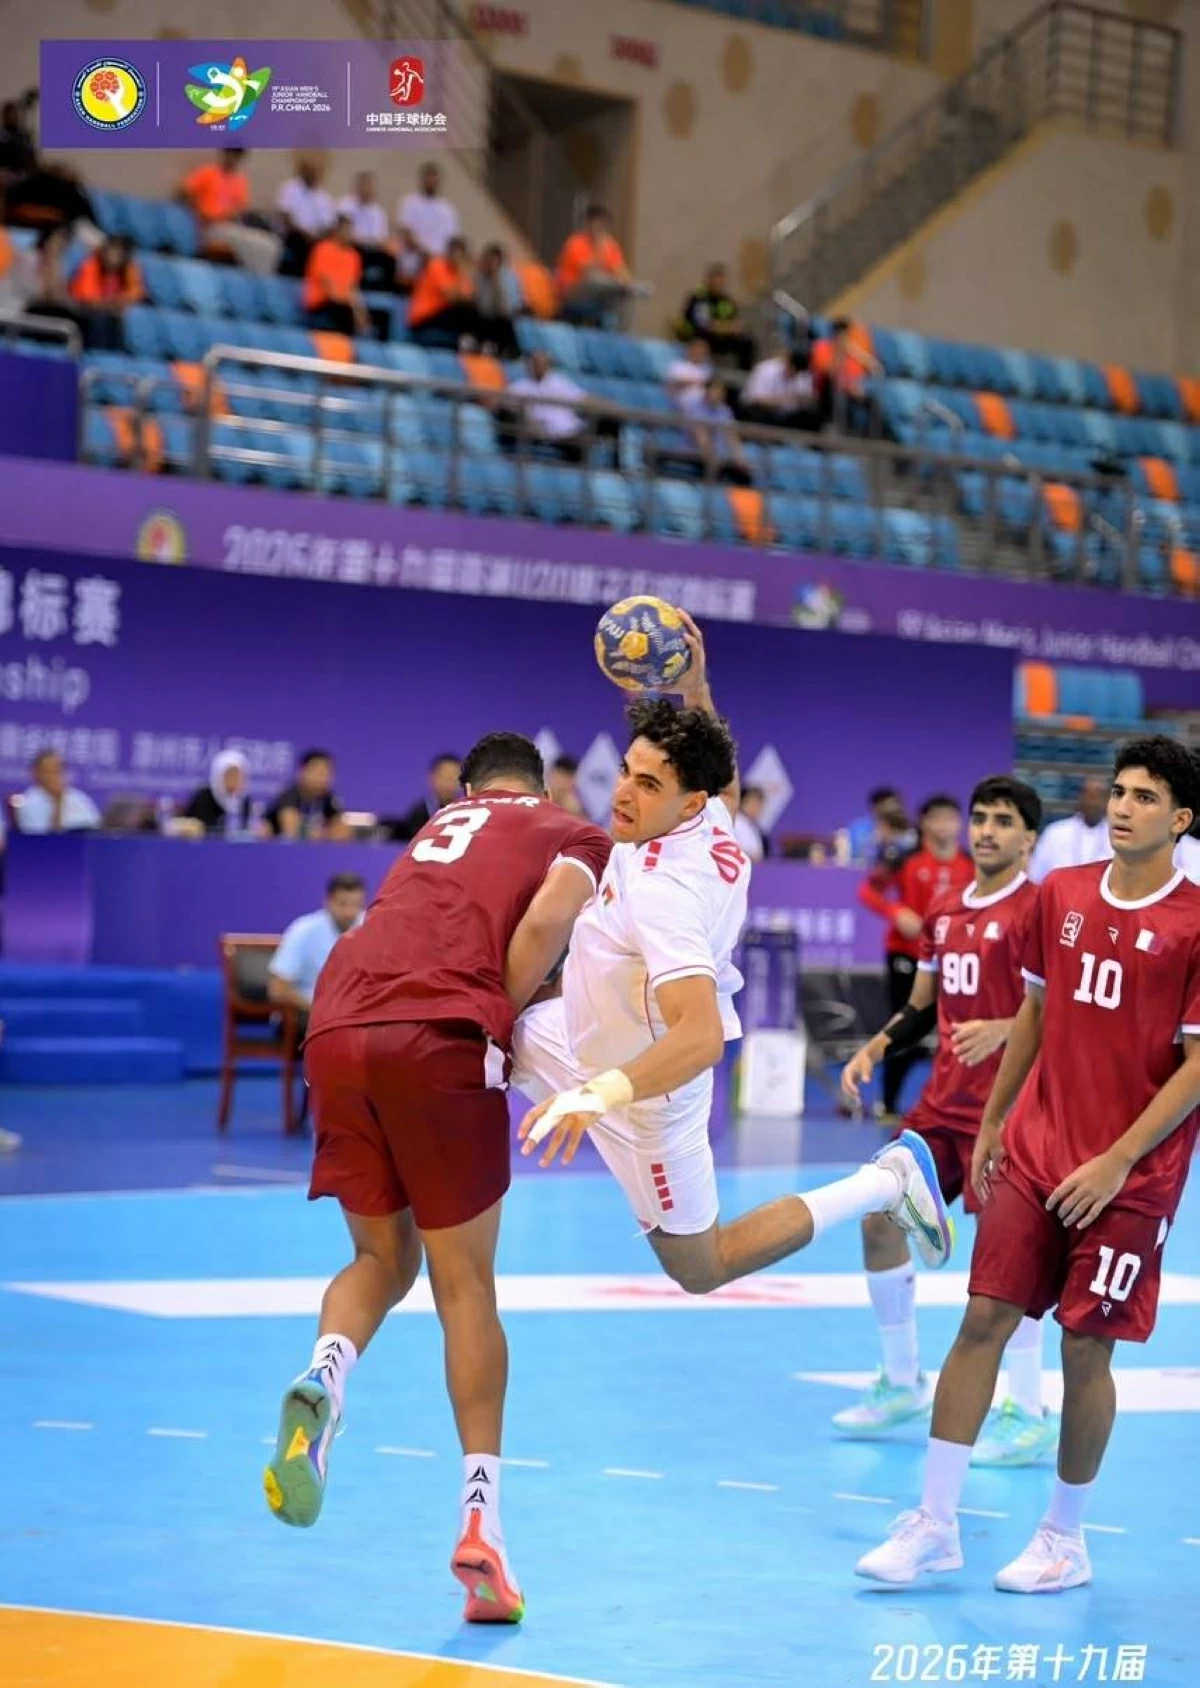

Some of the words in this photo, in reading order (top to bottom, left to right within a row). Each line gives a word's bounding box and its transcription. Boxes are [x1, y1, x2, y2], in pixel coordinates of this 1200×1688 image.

[411, 807, 492, 865] 3
[942, 952, 980, 996] 90
[1073, 951, 1123, 1011] 10
[1089, 1245, 1141, 1302] 10
